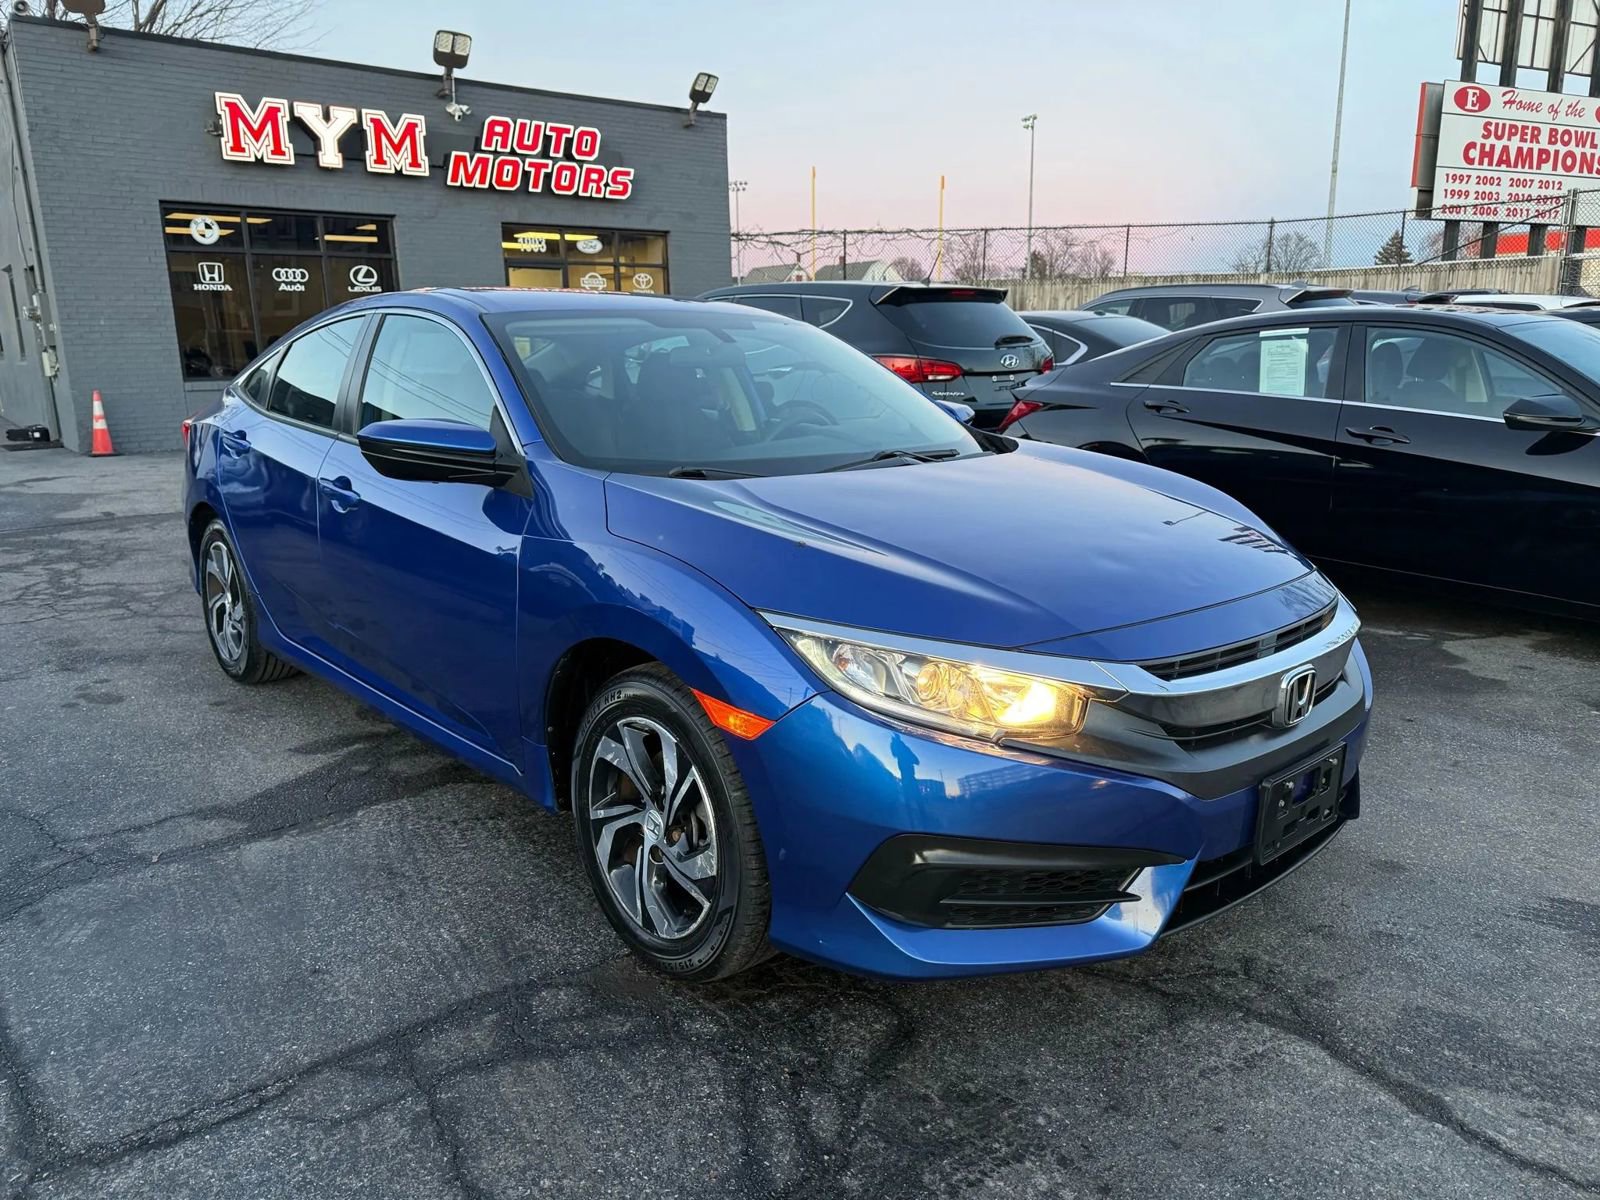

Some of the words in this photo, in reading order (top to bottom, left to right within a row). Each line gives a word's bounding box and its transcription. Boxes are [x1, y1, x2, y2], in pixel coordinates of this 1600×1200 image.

[1465, 88, 1480, 111] E
[1501, 89, 1543, 113] Home
[1547, 98, 1561, 121] of
[1565, 99, 1586, 118] the
[214, 91, 430, 177] MYM
[480, 115, 602, 162] AUTO
[1481, 120, 1542, 145] SUPER
[1547, 127, 1599, 150] BOWL
[447, 150, 636, 200] MOTORS
[1445, 173, 1472, 184] 1997
[1475, 175, 1502, 187] 2002
[1508, 177, 1535, 189] 2007
[1537, 179, 1563, 191] 2012
[1443, 188, 1470, 200] 1999
[1474, 190, 1500, 202] 2003
[1471, 206, 1499, 217] 2006
[193, 283, 233, 292] HONDA
[278, 282, 306, 292] Audi
[348, 285, 383, 293] LEXUS
